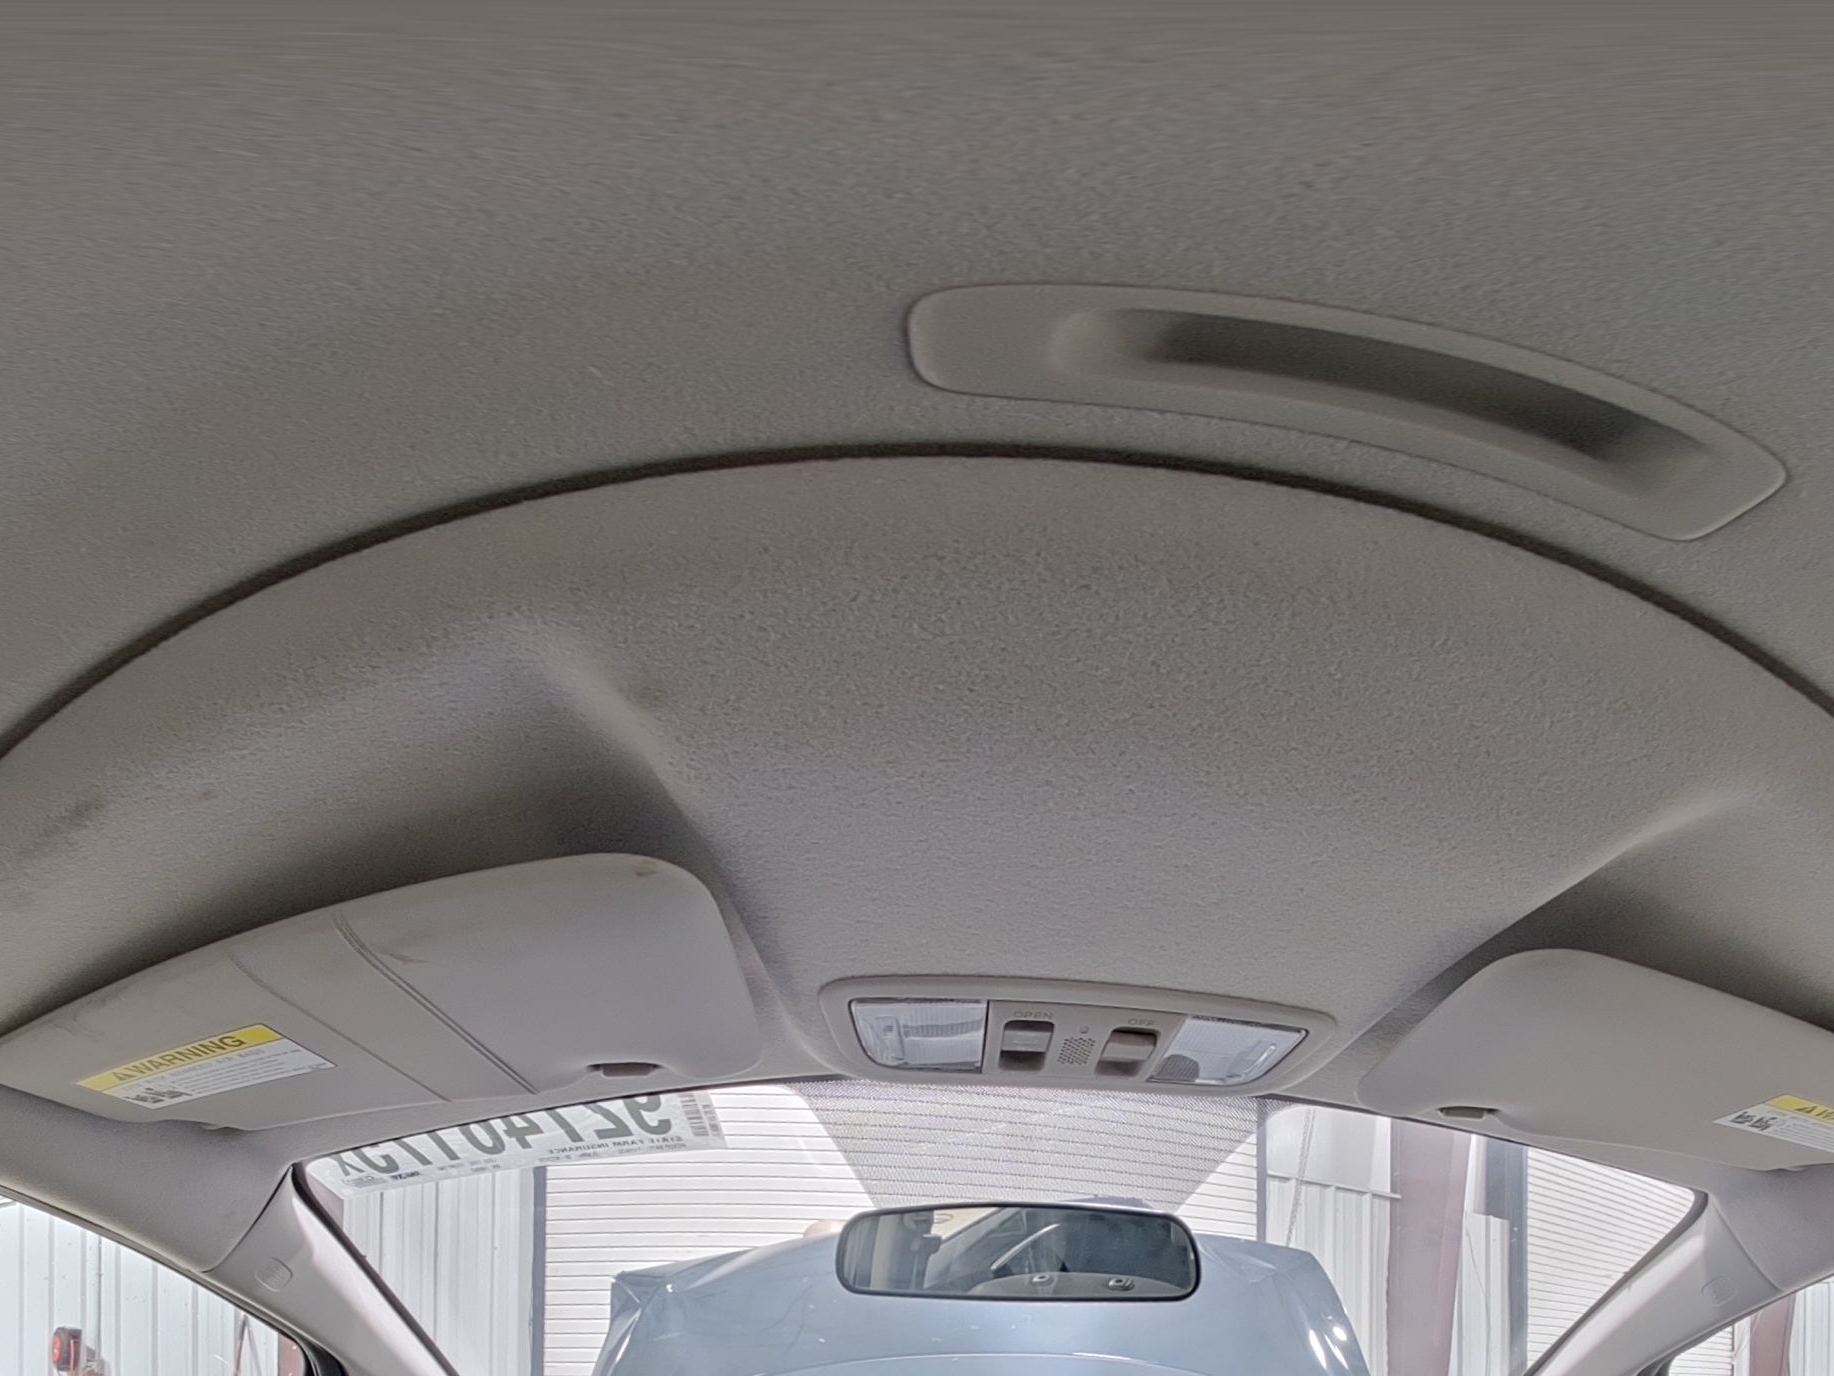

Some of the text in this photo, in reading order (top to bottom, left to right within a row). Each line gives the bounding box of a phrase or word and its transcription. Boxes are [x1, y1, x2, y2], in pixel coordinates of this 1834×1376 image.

[1013, 1010, 1053, 1020] OPEN
[1128, 1018, 1157, 1027] OFF
[126, 1035, 247, 1079] WARNING
